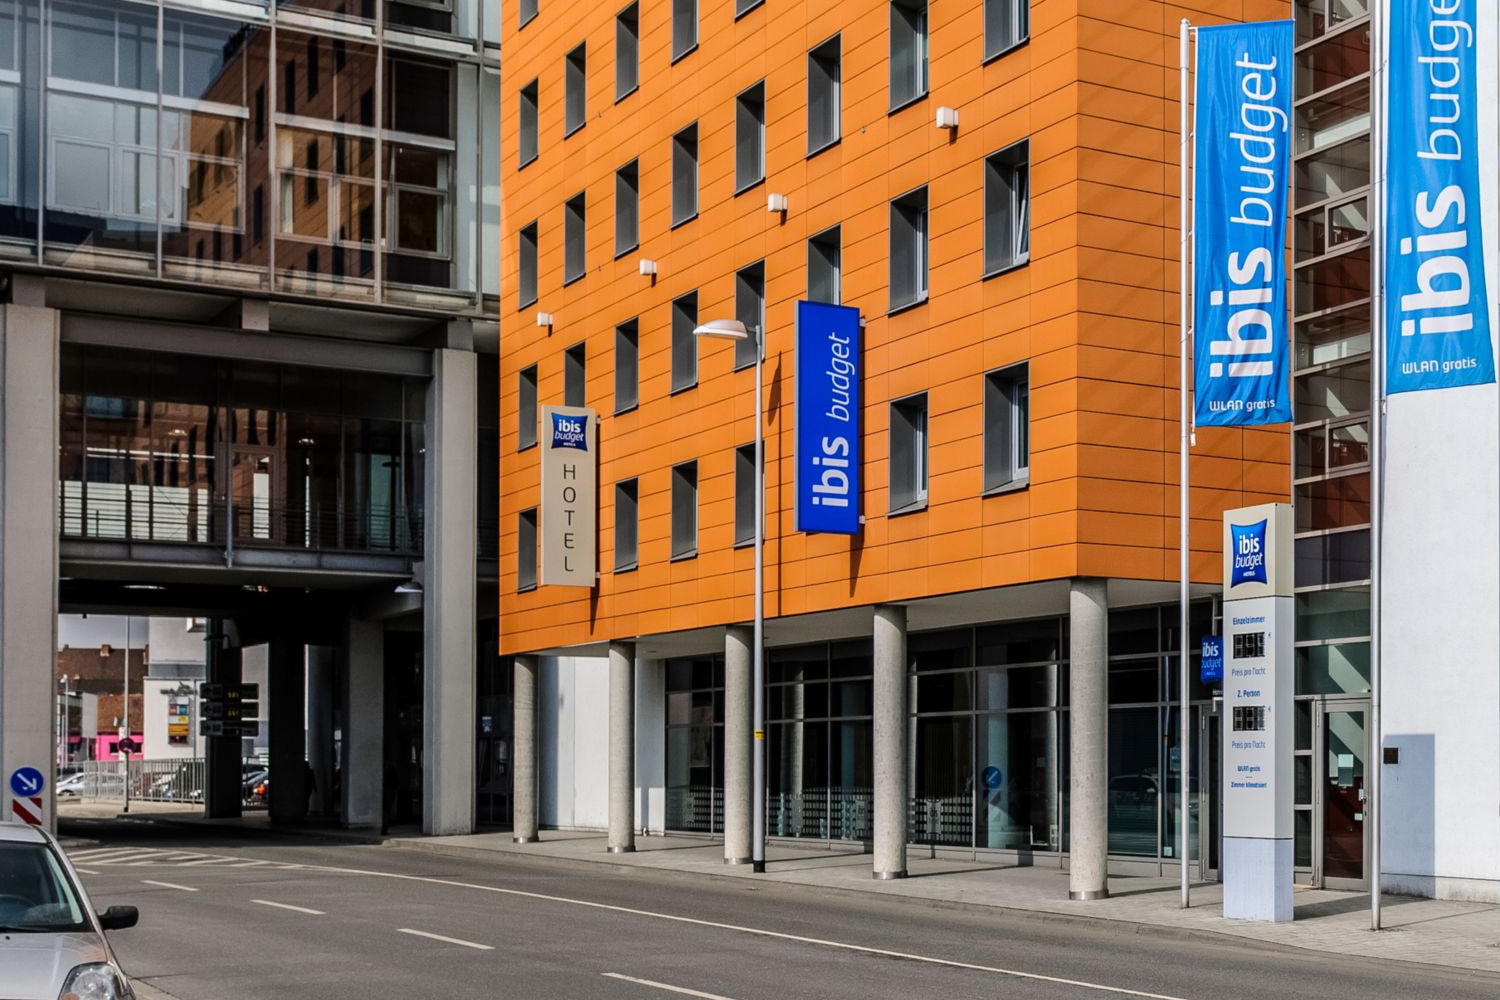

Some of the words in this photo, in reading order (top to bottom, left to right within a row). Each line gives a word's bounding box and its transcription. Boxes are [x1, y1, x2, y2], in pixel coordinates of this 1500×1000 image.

[1230, 52, 1288, 227] budget
[1401, 184, 1473, 336] ibis
[1210, 247, 1273, 378] ibis
[1402, 359, 1439, 374] WLAN
[1442, 357, 1477, 373] gratis
[825, 332, 855, 422] budget
[1209, 400, 1243, 412] WLAN
[1246, 399, 1275, 412] gratis
[558, 419, 581, 433] ibis
[554, 430, 584, 442] budget
[812, 436, 849, 507] ibis
[563, 464, 576, 572] HOTEL
[1239, 533, 1260, 554] ibis
[1235, 552, 1263, 570] budget
[1232, 616, 1265, 625] Einzelzimmer
[1202, 641, 1219, 657] ibis
